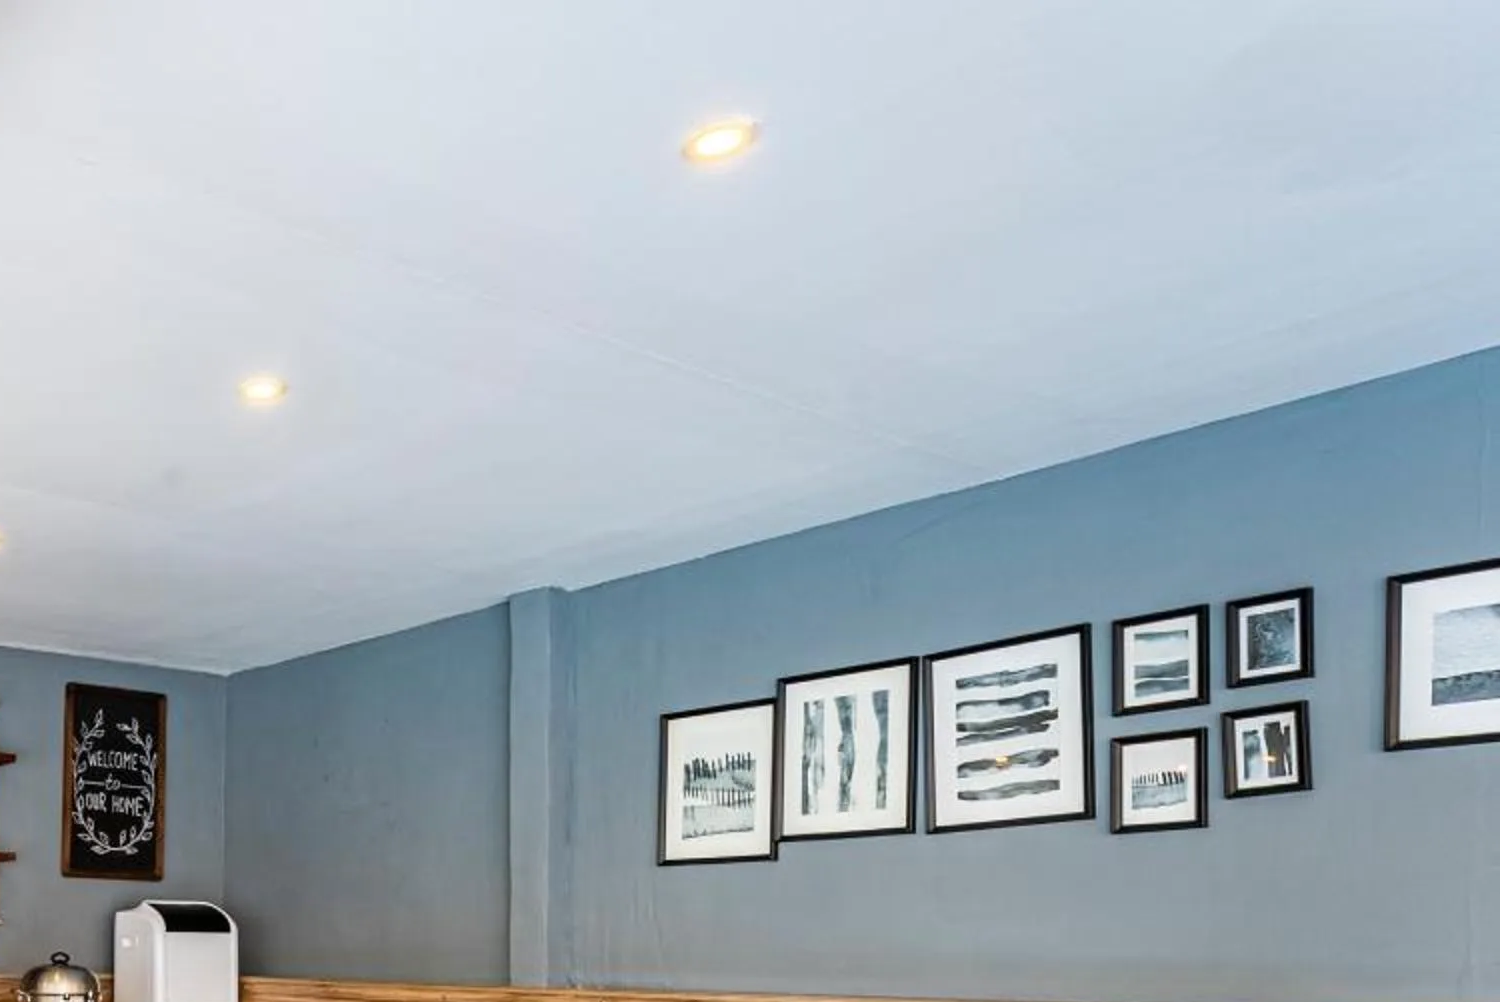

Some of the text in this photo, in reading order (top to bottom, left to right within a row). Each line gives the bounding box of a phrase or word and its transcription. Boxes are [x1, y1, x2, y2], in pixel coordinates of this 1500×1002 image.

[87, 750, 138, 770] WELCOME
[105, 773, 121, 790] to
[85, 791, 145, 817] OUR HOME
